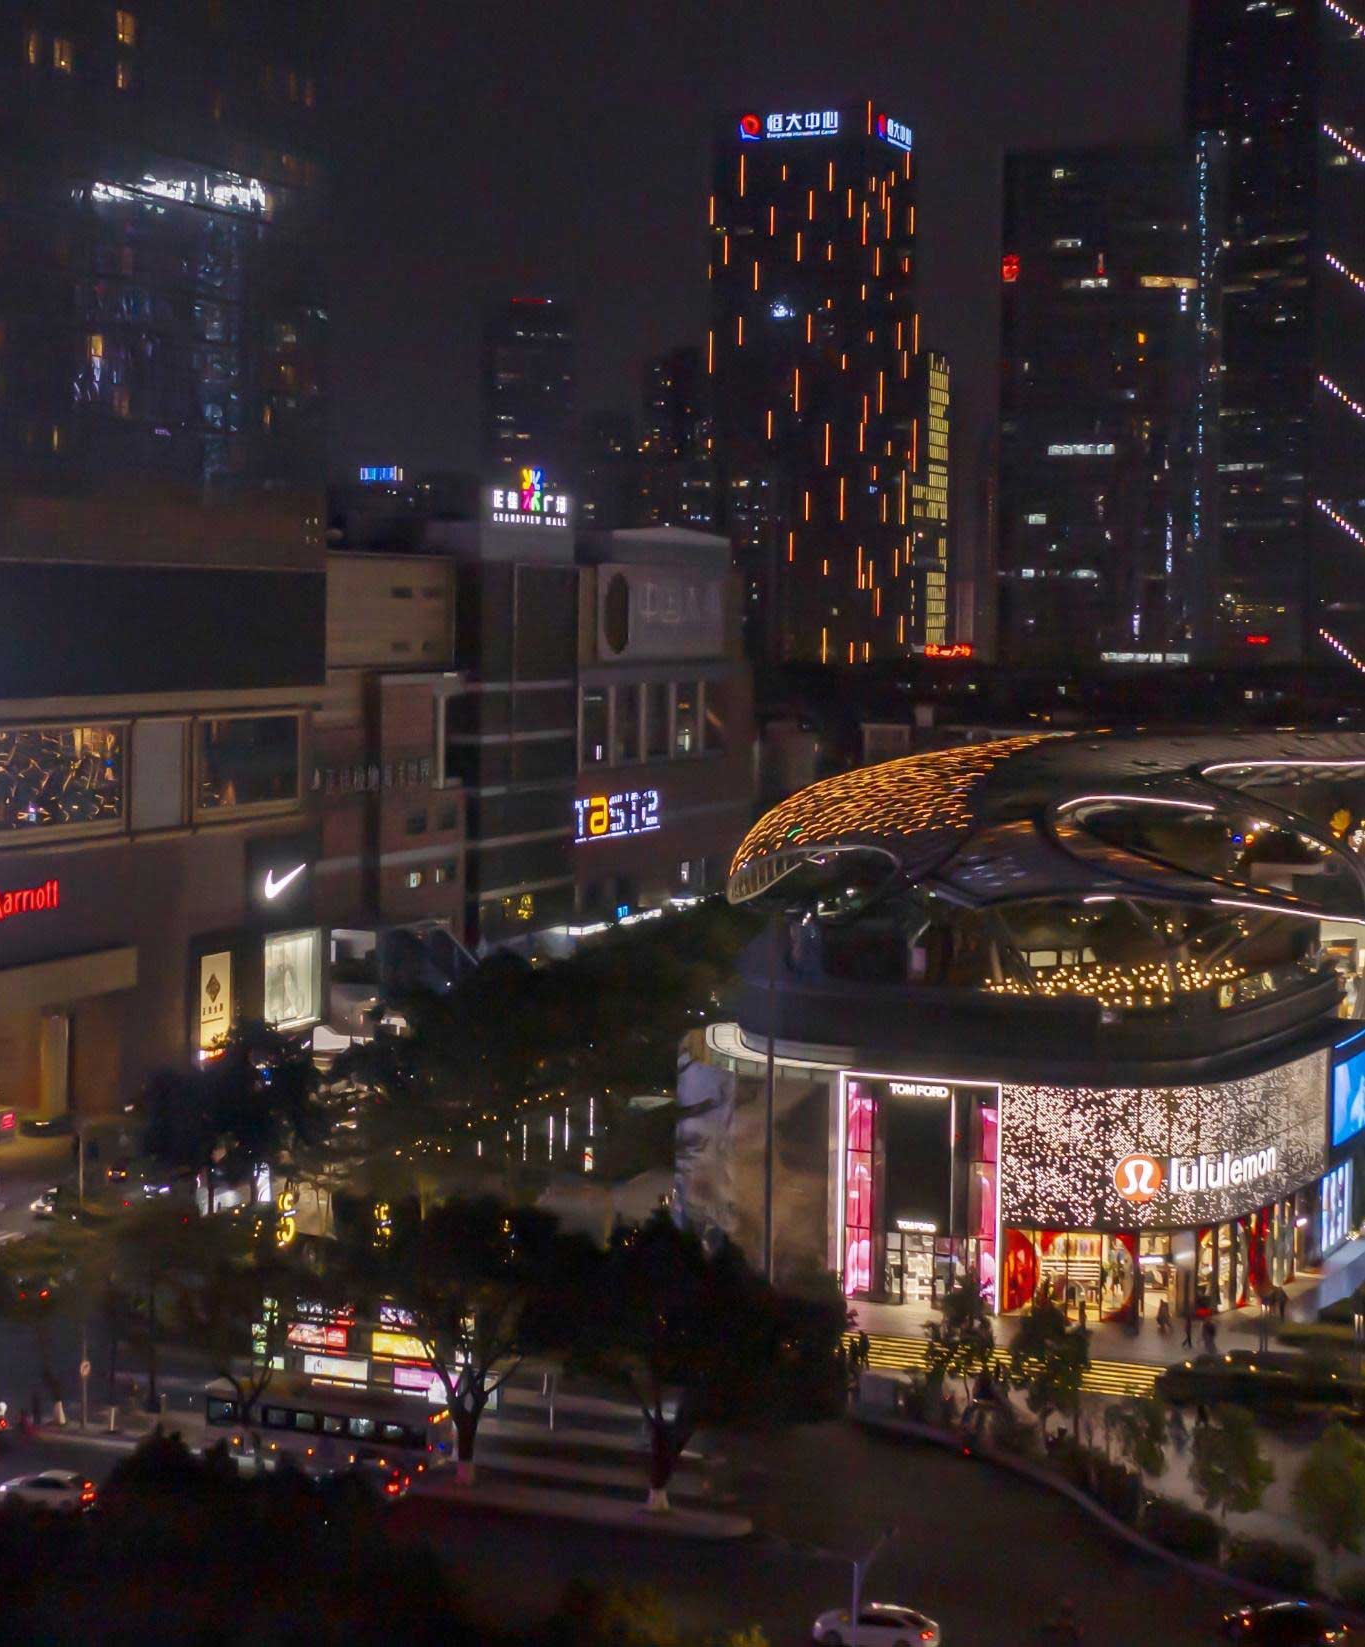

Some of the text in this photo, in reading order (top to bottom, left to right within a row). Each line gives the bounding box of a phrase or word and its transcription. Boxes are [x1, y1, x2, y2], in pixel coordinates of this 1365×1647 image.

[767, 111, 839, 132] 恒大中心
[889, 1082, 949, 1098] TOM FORD
[1169, 1146, 1277, 1195] lululemon
